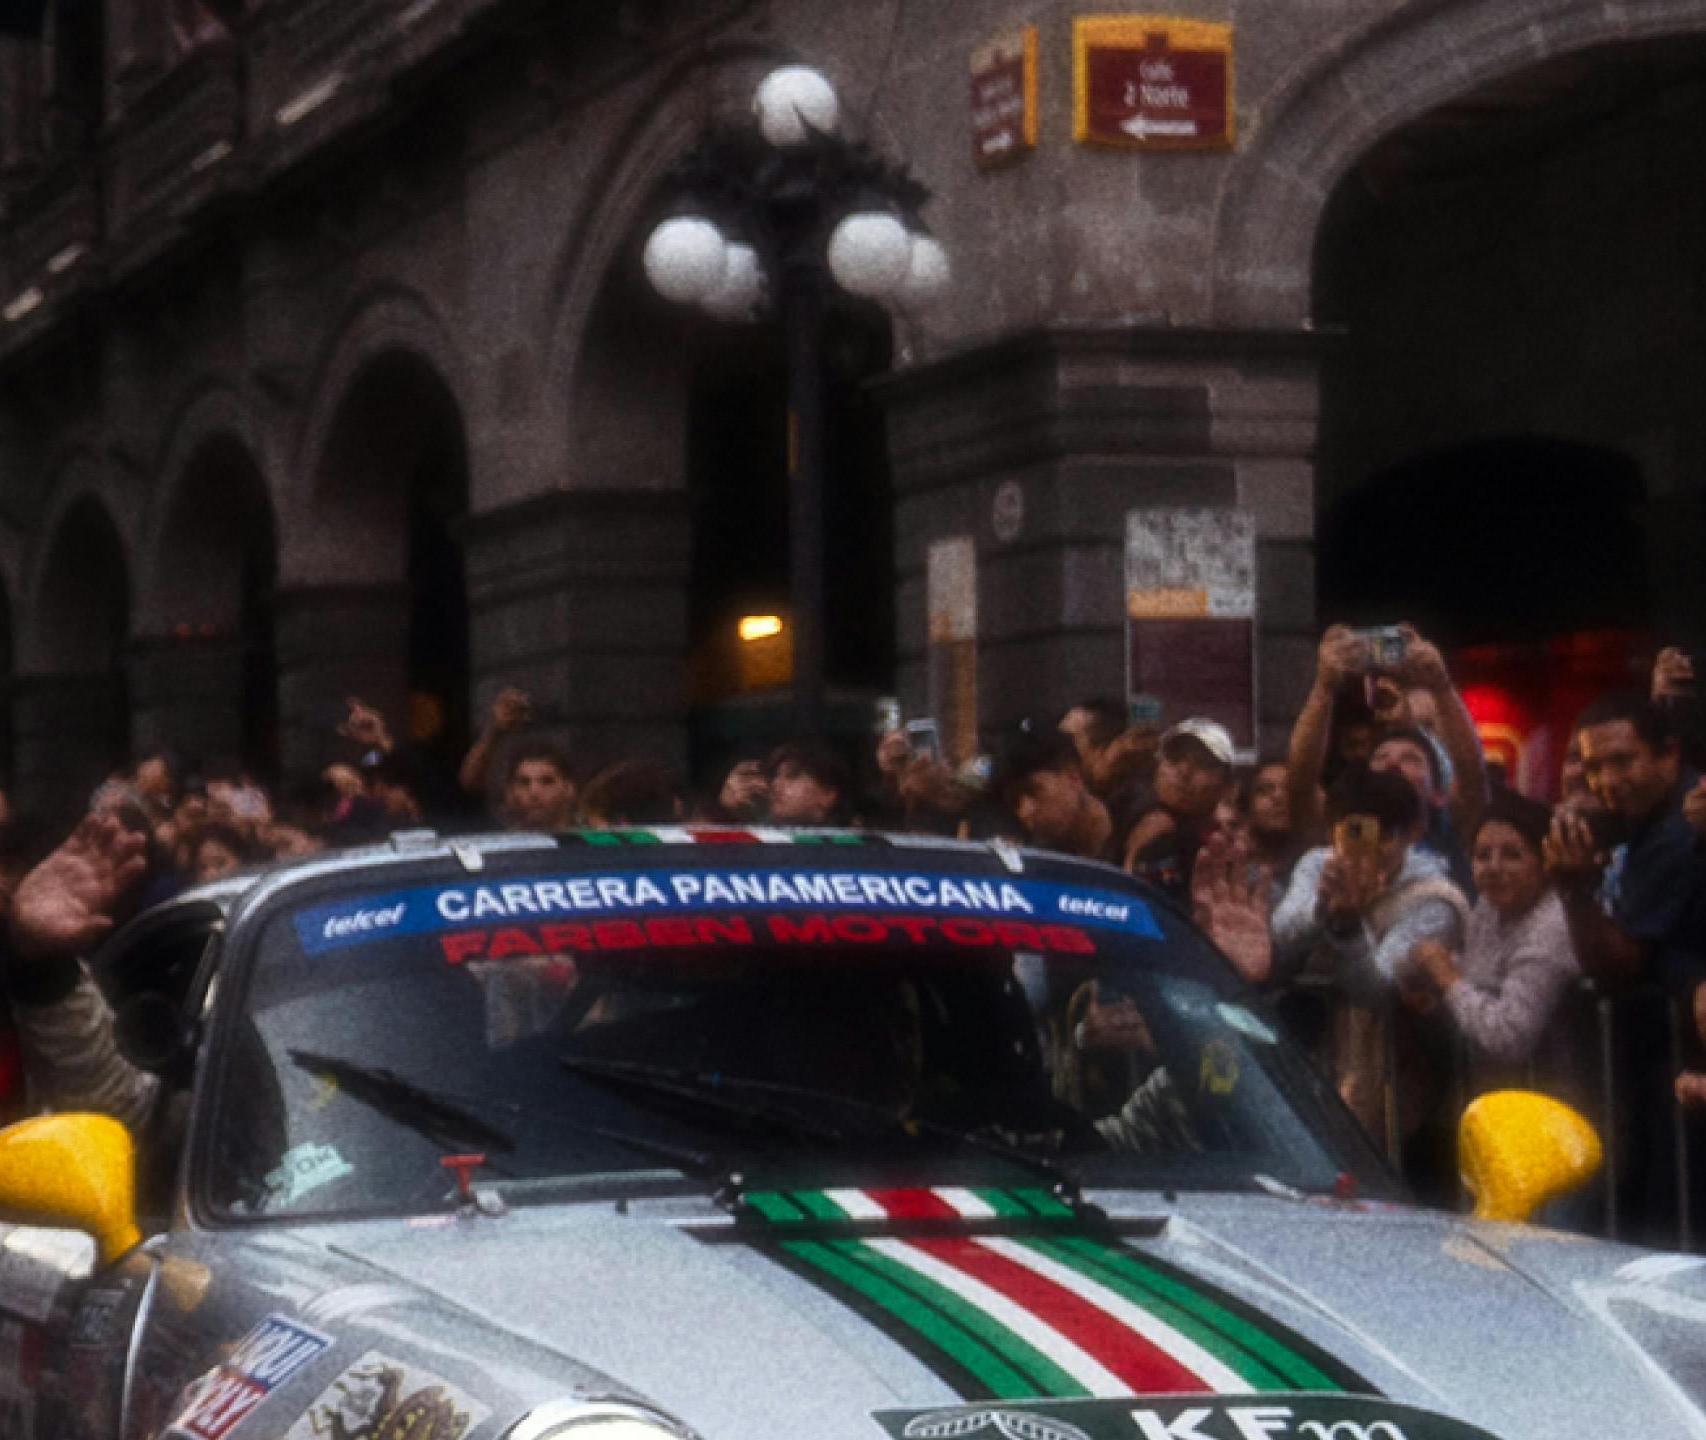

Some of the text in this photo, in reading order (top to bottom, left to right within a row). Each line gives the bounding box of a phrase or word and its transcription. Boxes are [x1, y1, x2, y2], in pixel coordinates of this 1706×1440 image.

[437, 873, 1033, 920] CARRERA PANAMERICANA
[1058, 895, 1130, 922] telcel
[322, 903, 405, 938] telcel
[441, 915, 1096, 963] FARBEN MOTORS
